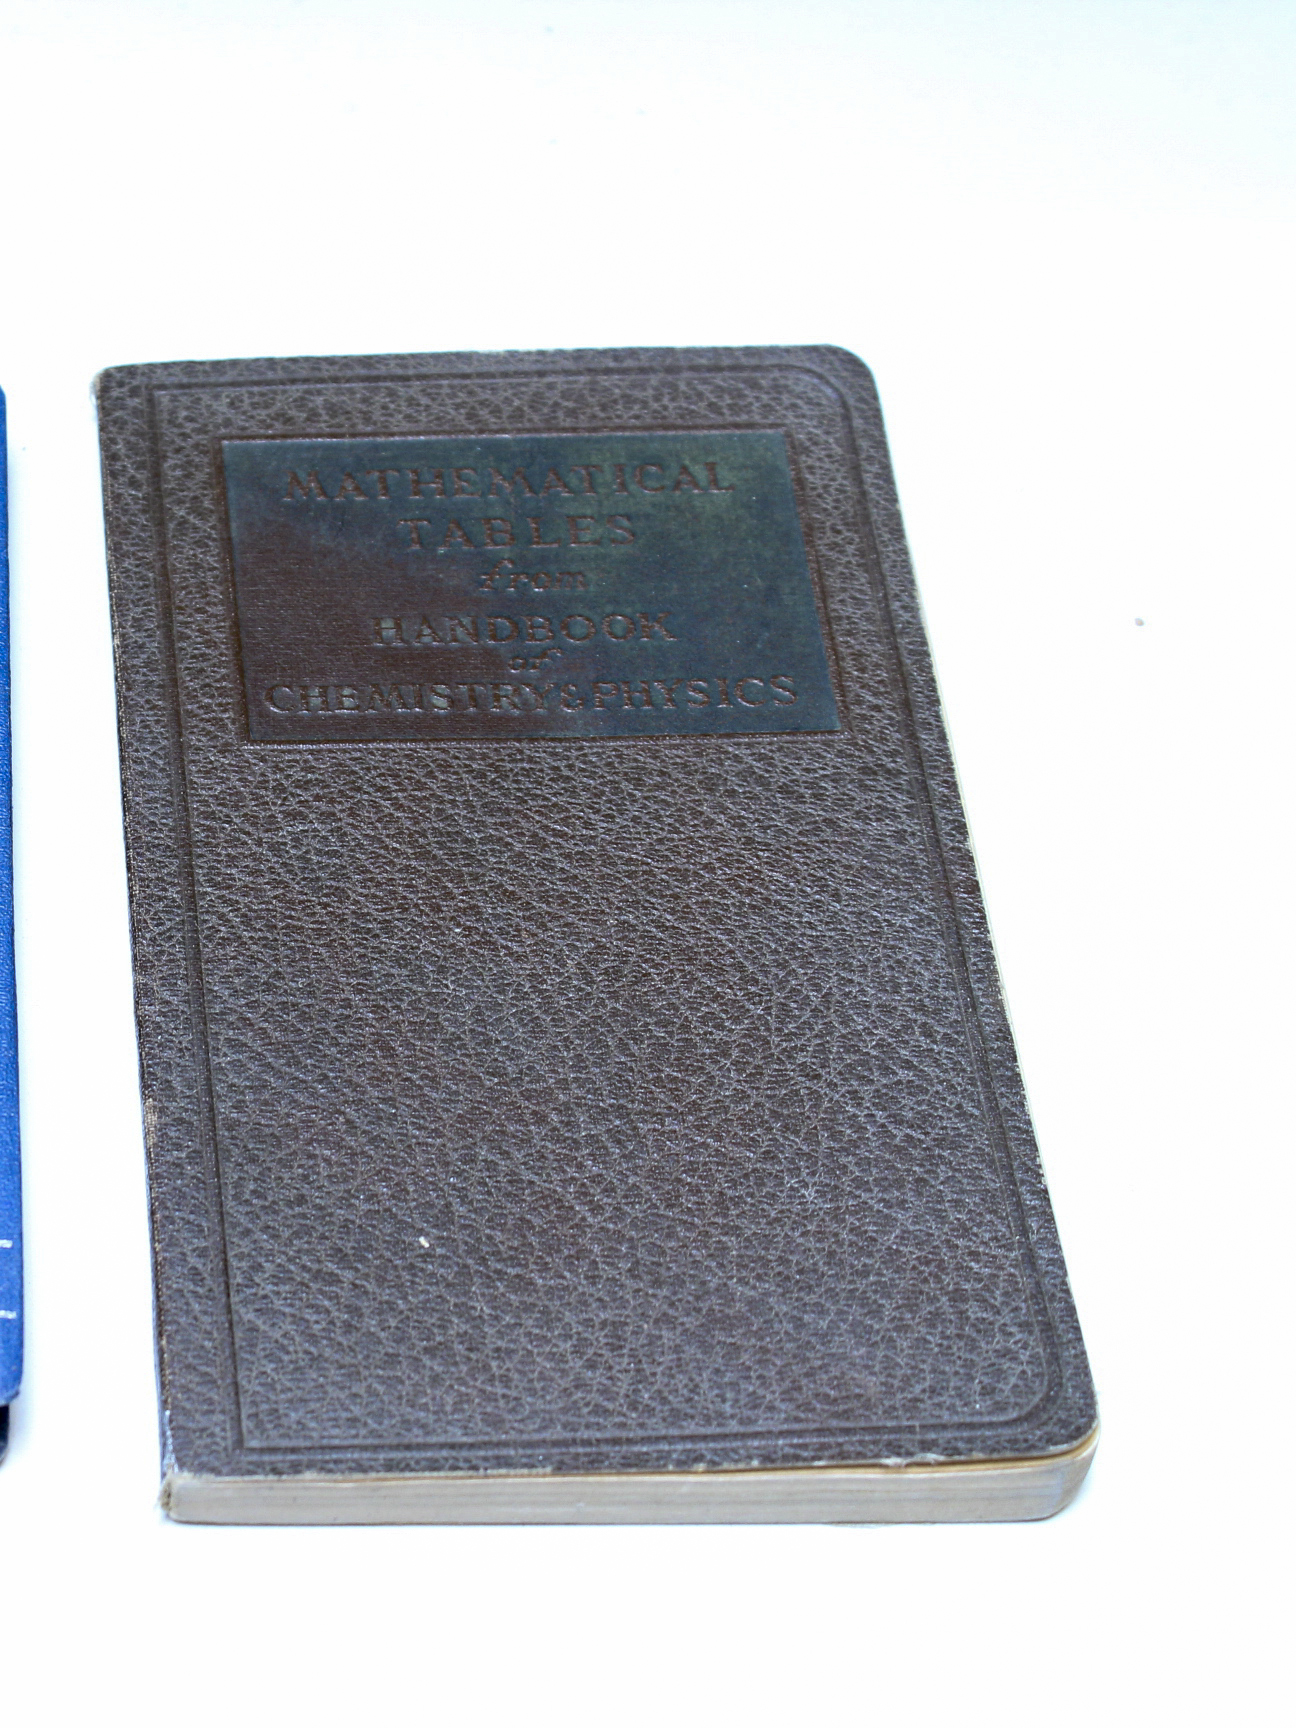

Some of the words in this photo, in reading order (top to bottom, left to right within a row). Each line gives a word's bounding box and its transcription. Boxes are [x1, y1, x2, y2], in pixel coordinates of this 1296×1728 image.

[284, 461, 736, 500] MATHEMATICAL
[398, 515, 636, 551] TABLES
[373, 612, 679, 648] HANDBOOK
[508, 647, 564, 673] of
